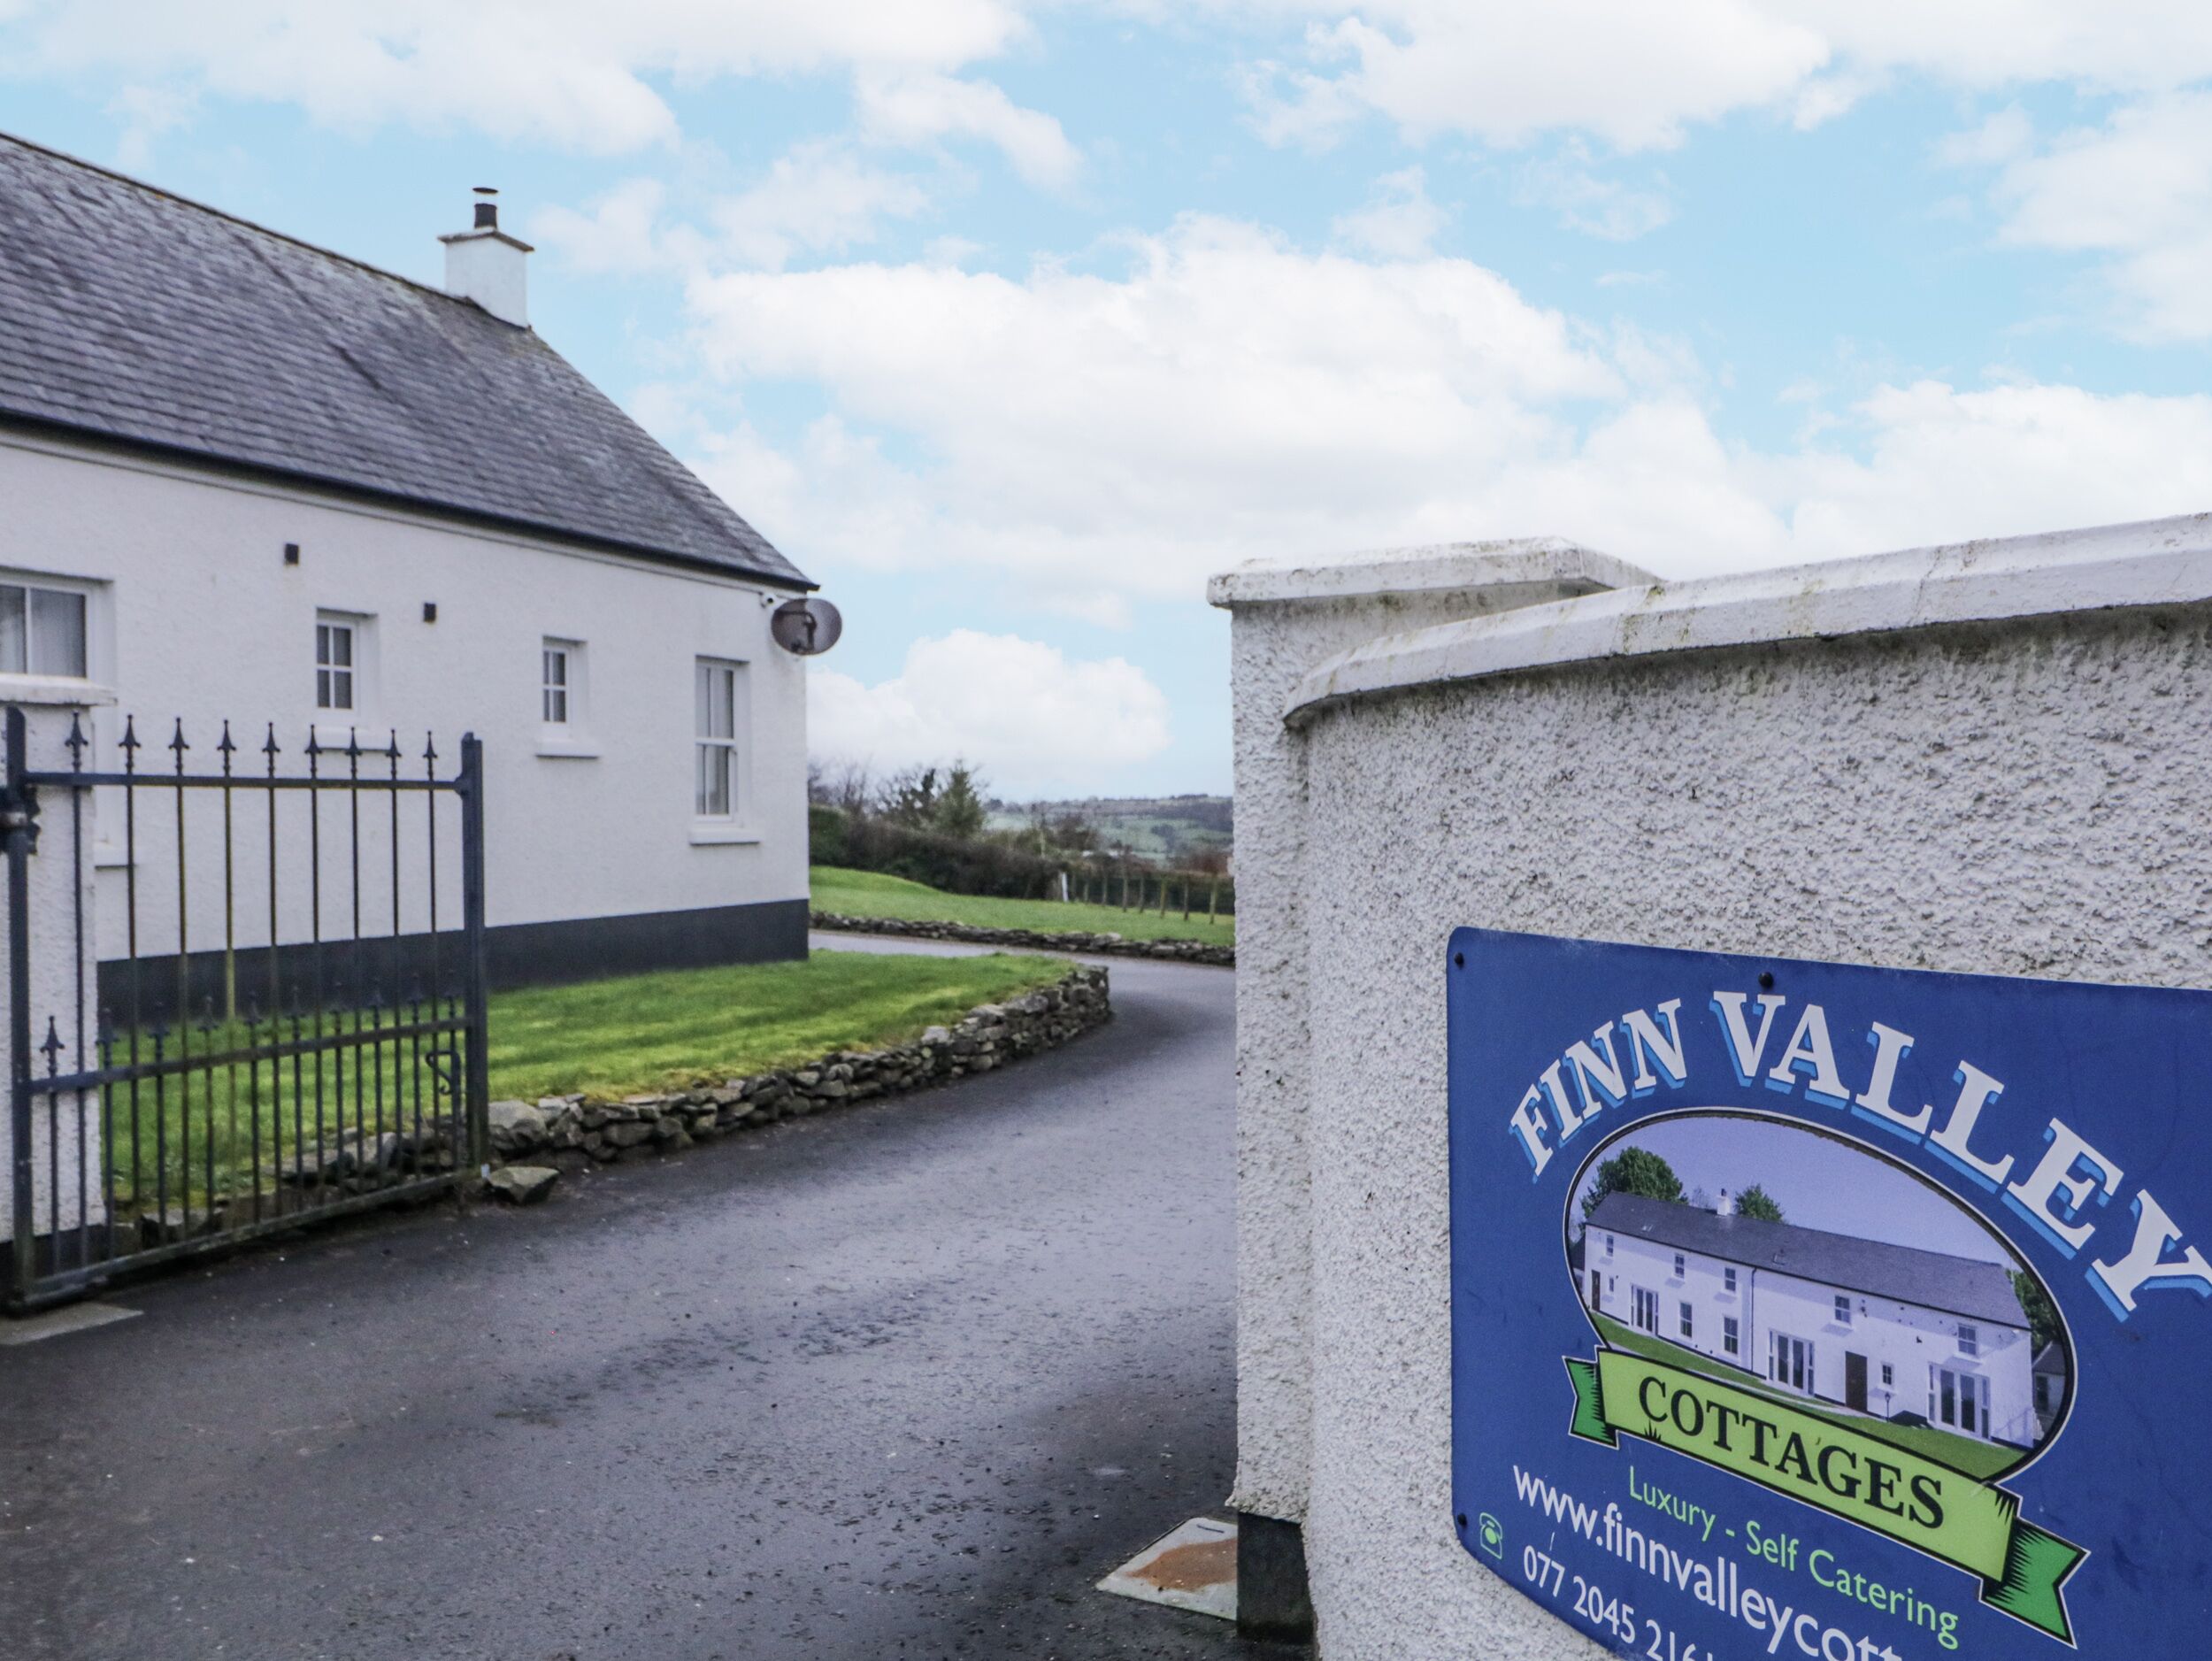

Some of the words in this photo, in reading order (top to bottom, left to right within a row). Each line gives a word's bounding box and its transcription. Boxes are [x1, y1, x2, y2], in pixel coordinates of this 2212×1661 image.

[1509, 997, 1686, 1181] FINN
[1710, 990, 2212, 1319] VALLEY
[1638, 1375, 1945, 1530] COTTAGES
[1523, 1544, 1566, 1598] 077
[1572, 1575, 1636, 1644] 2045
[1629, 1465, 1717, 1542] Luxury
[1746, 1519, 1800, 1572] Self
[1809, 1549, 1959, 1650] Catering
